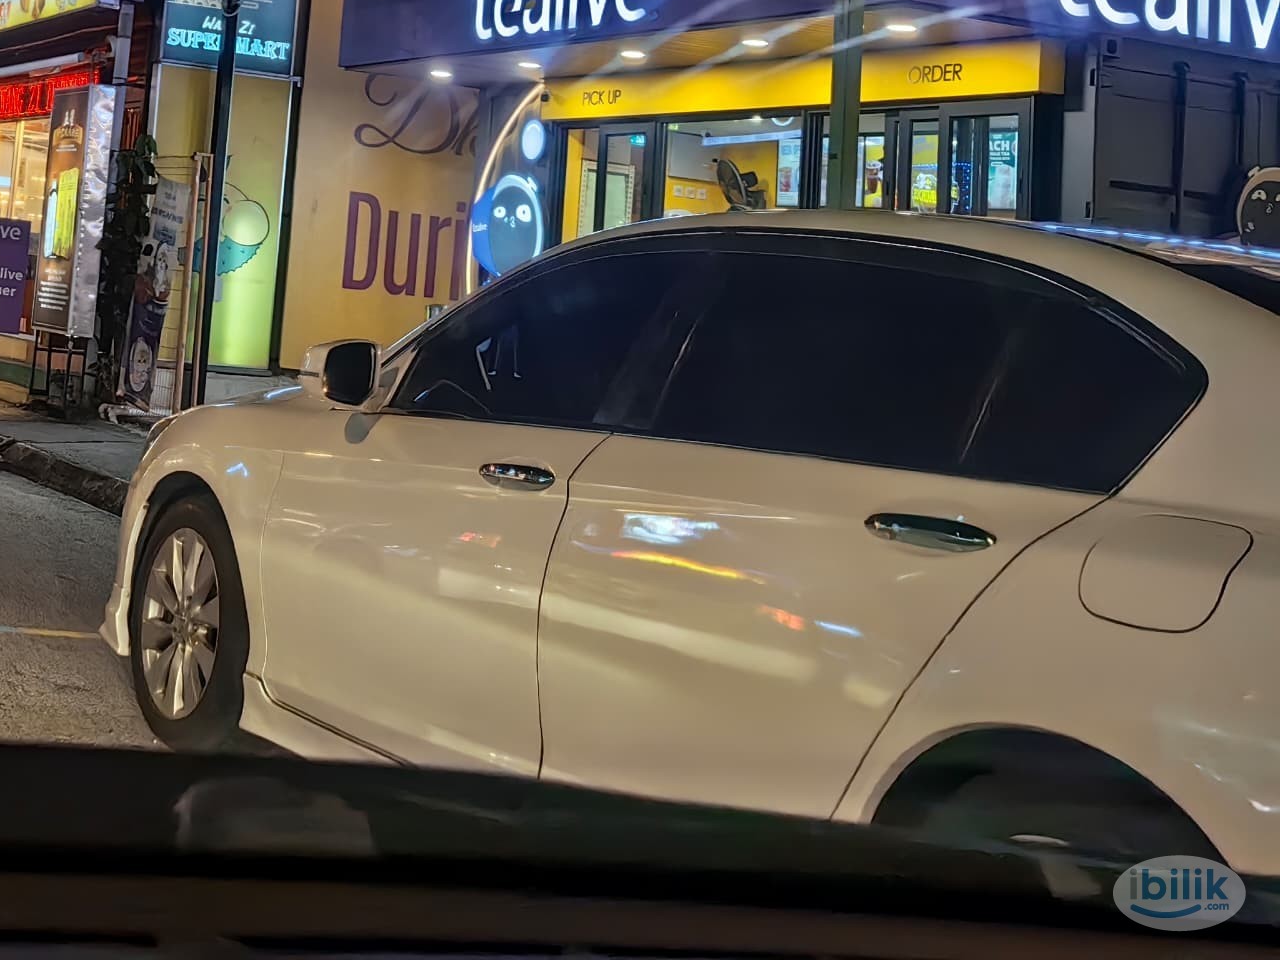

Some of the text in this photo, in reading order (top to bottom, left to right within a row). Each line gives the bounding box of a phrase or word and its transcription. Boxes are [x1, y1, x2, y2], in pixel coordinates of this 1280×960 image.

[166, 27, 291, 61] SUPEMART
[908, 63, 963, 85] ORDER
[582, 89, 622, 107] PICK UP
[341, 190, 471, 302] Duri
